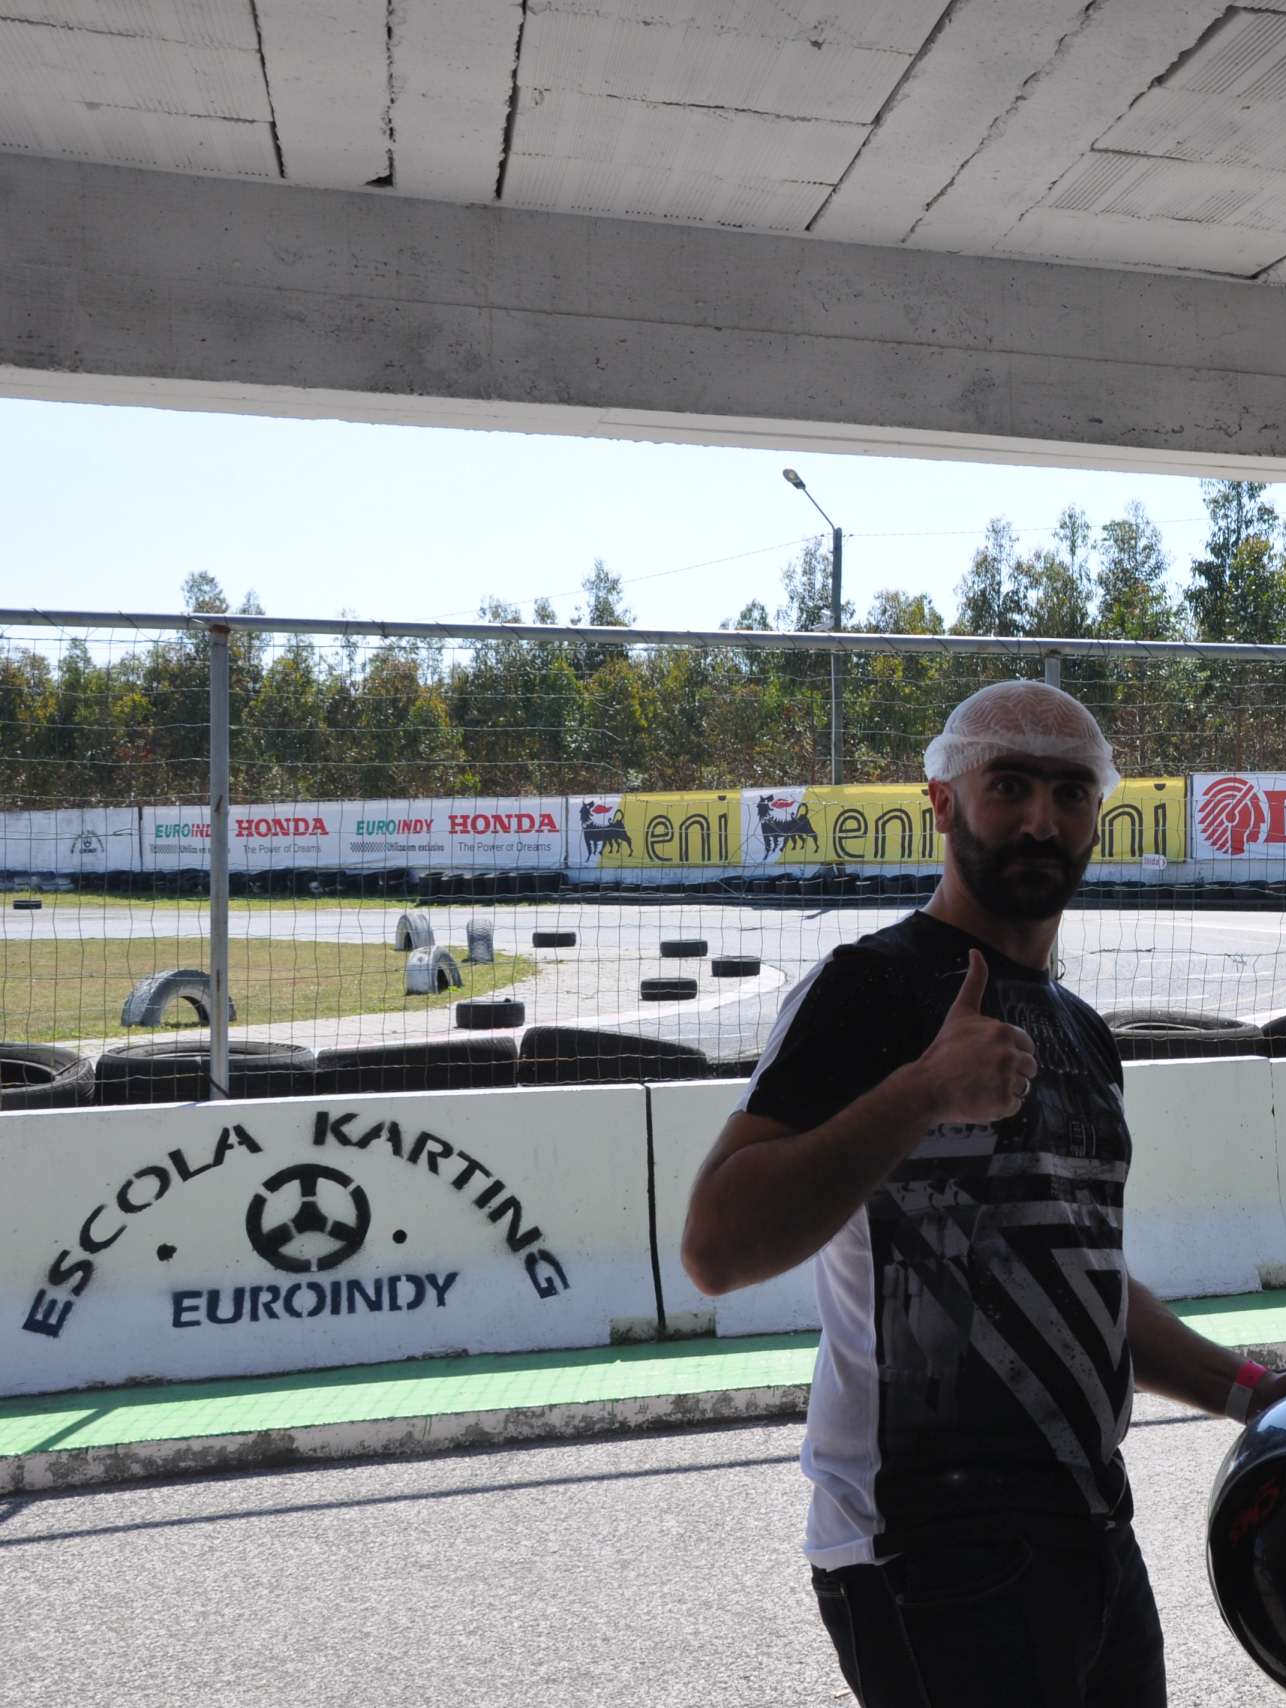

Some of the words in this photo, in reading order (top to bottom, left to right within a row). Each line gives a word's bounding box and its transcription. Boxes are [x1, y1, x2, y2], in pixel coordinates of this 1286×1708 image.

[155, 823, 211, 838] EUROIND
[235, 818, 329, 838] HONDA
[356, 819, 434, 836] EUROINDY
[448, 813, 560, 835] HONDA
[646, 795, 728, 862] eni
[833, 789, 936, 860] eni
[1101, 783, 1166, 858] ni
[458, 841, 474, 851] The
[477, 840, 503, 851] Power
[505, 840, 513, 851] of
[517, 840, 552, 851] Dreams
[22, 1124, 263, 1338] ESCOLA
[313, 1111, 571, 1300] KARTING
[172, 1271, 459, 1328] EUROINDY
